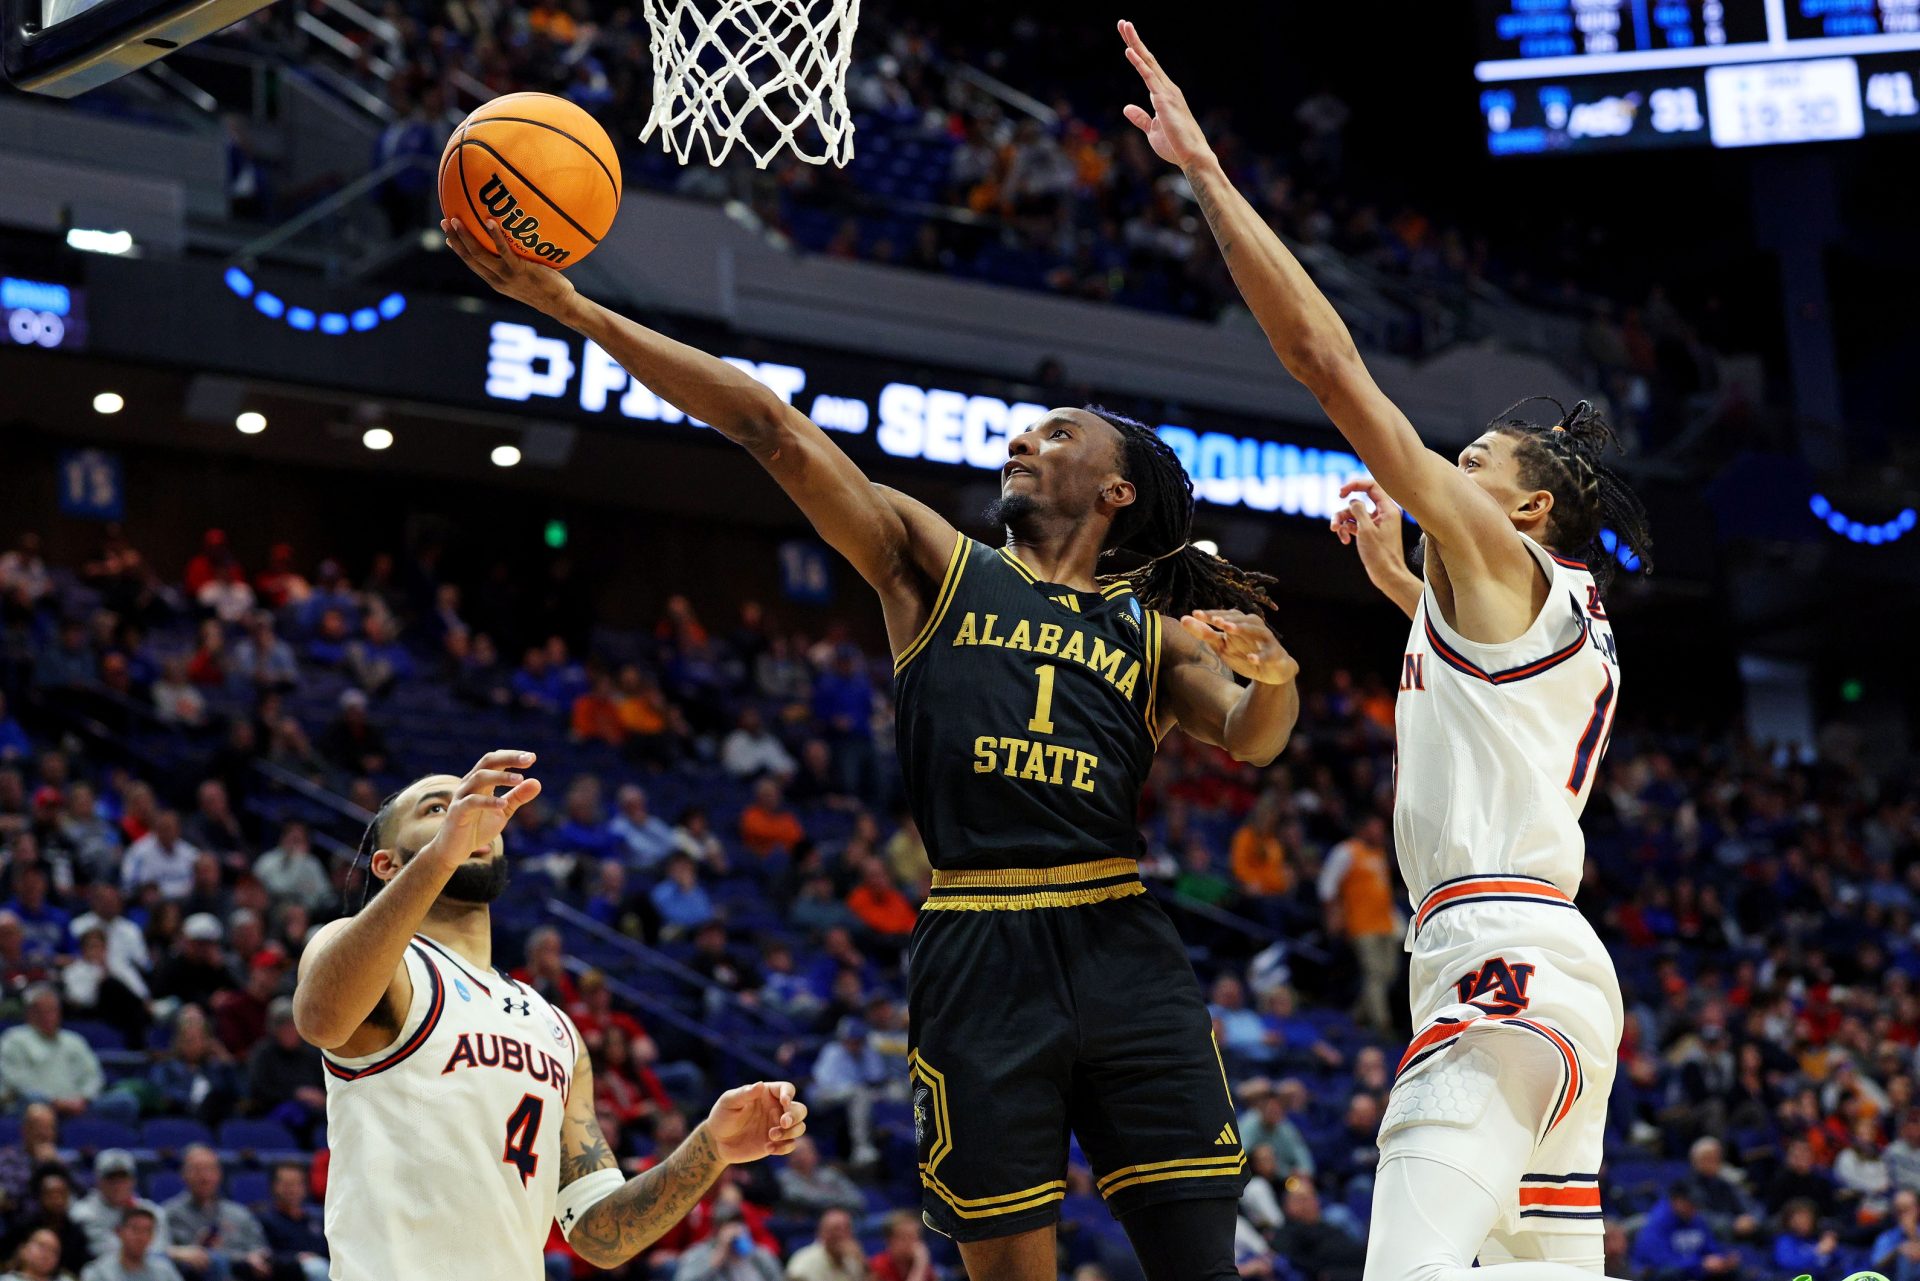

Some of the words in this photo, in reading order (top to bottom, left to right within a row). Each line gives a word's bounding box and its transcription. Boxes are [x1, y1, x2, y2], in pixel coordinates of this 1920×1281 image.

[478, 172, 571, 263] Wilson
[953, 611, 1143, 701] ALABAMA
[1028, 664, 1056, 735] 1
[973, 735, 1098, 793] STATE
[441, 1033, 570, 1098] AUBUR
[502, 1092, 544, 1190] 4
